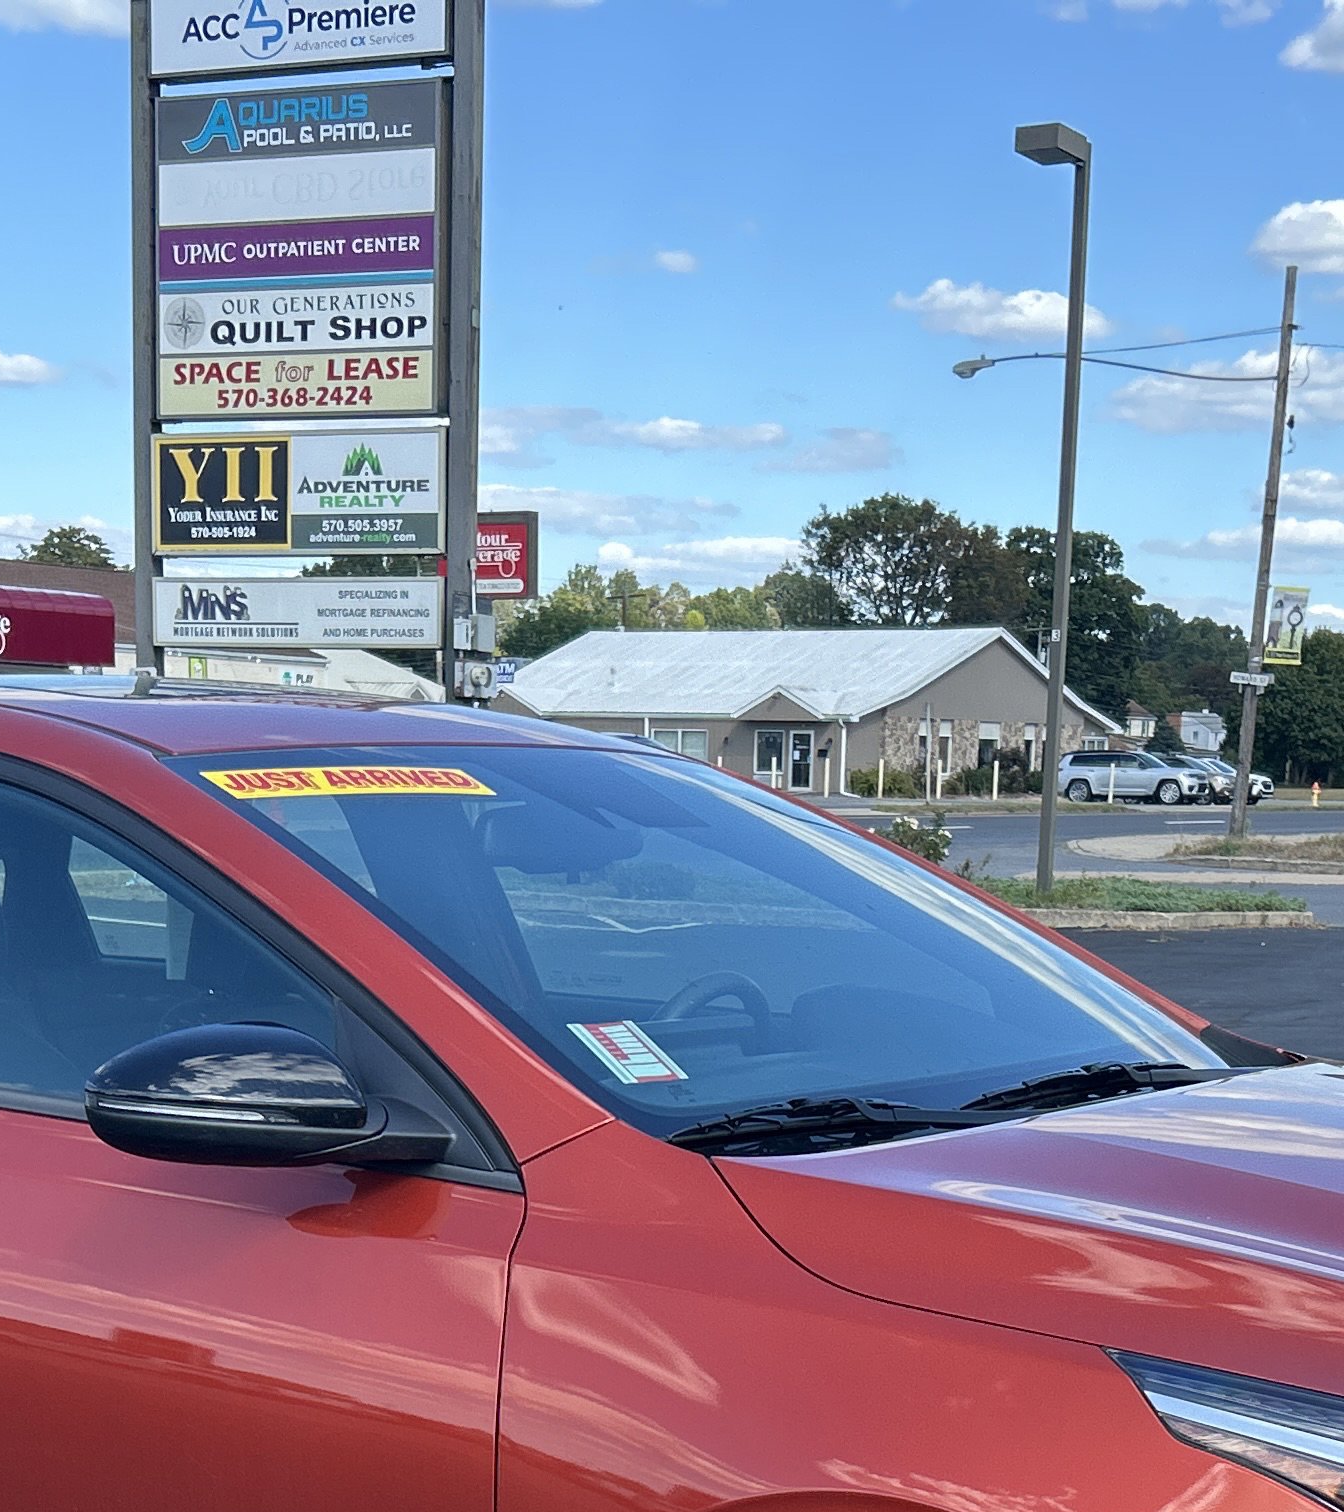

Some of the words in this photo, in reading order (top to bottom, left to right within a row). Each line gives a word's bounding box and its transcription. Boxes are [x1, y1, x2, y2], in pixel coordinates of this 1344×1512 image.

[182, 13, 240, 43] ACC
[288, 0, 416, 34] Premiere
[294, 33, 347, 51] Advanced
[350, 35, 366, 47] CX
[369, 32, 415, 46] Services
[182, 93, 369, 154] AQUARIUS
[243, 128, 295, 148] POOL
[300, 126, 314, 143] &
[320, 121, 380, 142] PATIO,
[384, 124, 413, 138] LLC
[172, 242, 237, 265] UPMC
[243, 239, 346, 259] OUTPATIENT
[351, 235, 420, 254] CENTER
[221, 298, 260, 315] OUR
[272, 291, 416, 315] GENERATIONS
[210, 319, 315, 346] QUILT
[328, 315, 428, 341] SHOP
[173, 361, 261, 385] SPACE
[275, 361, 314, 382] for
[326, 356, 419, 381] LEASE
[217, 385, 373, 409] 570-368-2424
[168, 446, 279, 503] YII
[297, 476, 430, 494] ADVENTURE
[319, 494, 406, 509] REALTY
[191, 526, 257, 539] 570-505-1924
[322, 519, 403, 532] 570.505.3957
[477, 531, 510, 547] tour
[338, 589, 398, 600] SPECIALIZING
[400, 590, 409, 600] IN
[317, 608, 367, 618] MORTGAGE
[370, 607, 430, 618] REFINANCING
[322, 628, 341, 638] AND
[342, 628, 369, 638] HOME
[370, 628, 425, 638] PURCHASES
[224, 770, 313, 792] JUST
[321, 769, 478, 790] ARRIVED
